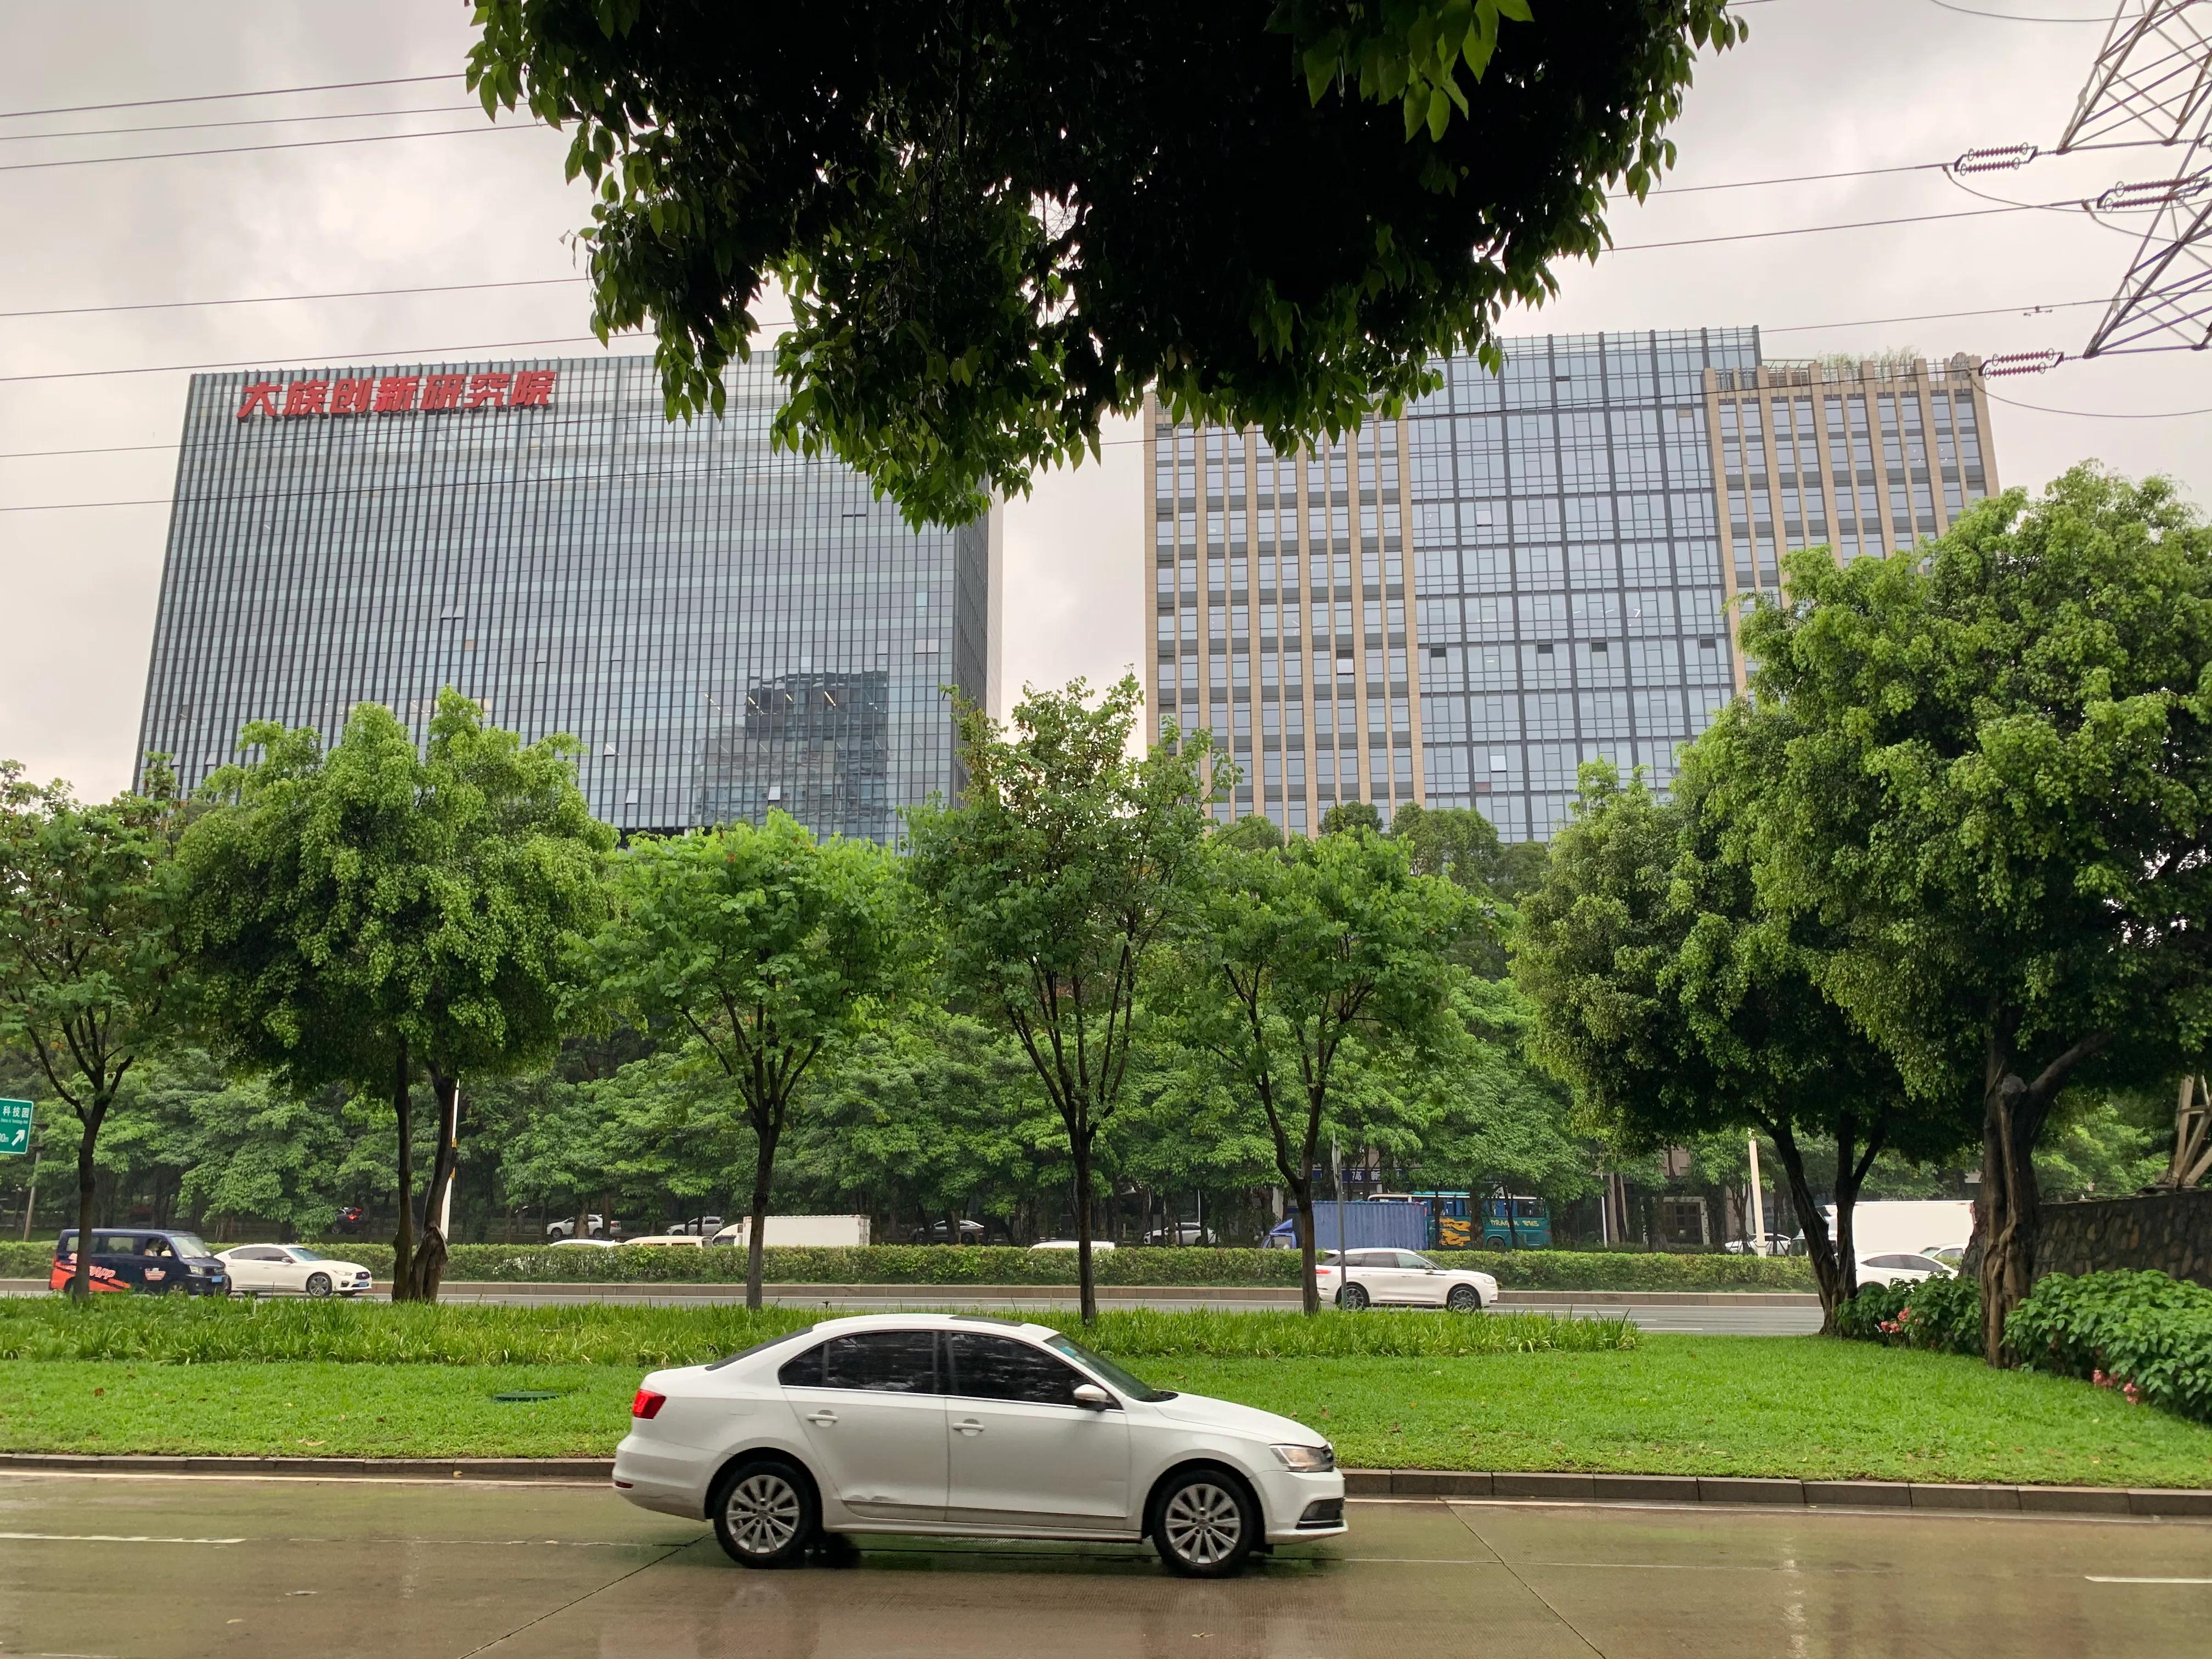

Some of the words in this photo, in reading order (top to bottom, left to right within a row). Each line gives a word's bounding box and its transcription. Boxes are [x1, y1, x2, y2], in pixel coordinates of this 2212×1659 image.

[237, 370, 556, 418] 大族创新研究院
[3, 1105, 30, 1118] 科技园
